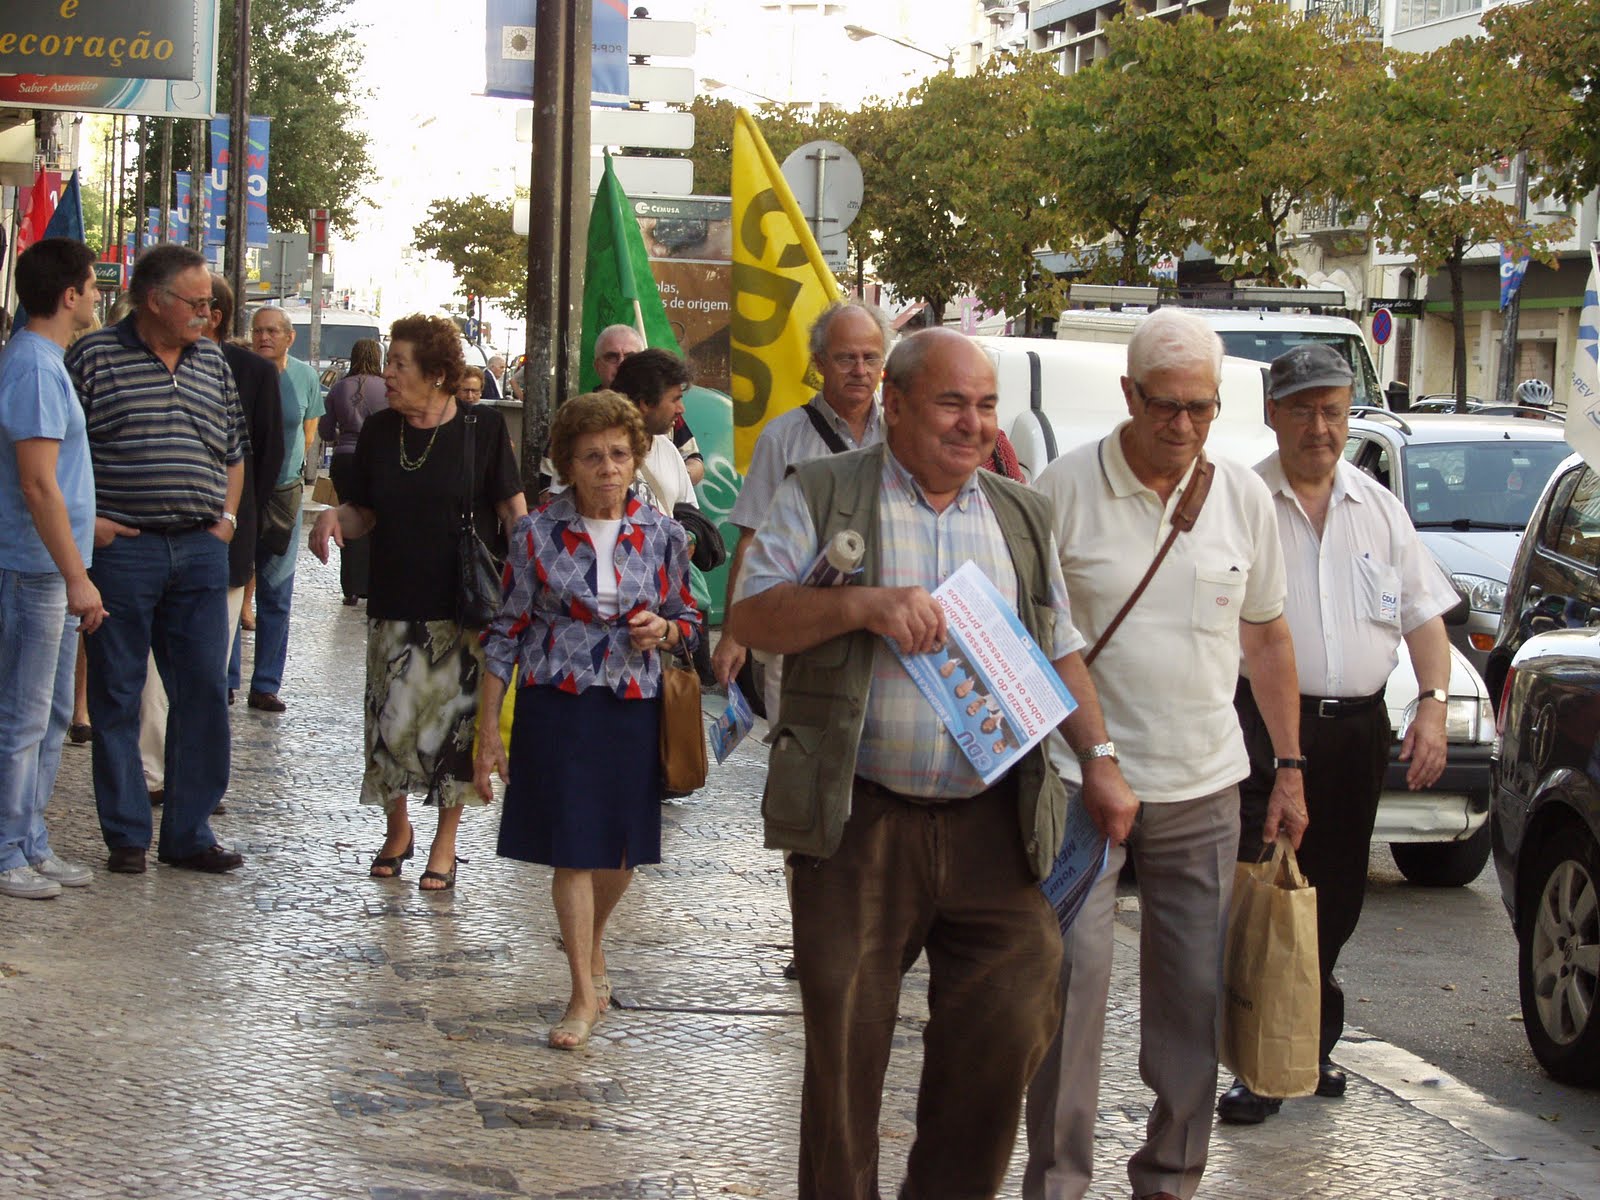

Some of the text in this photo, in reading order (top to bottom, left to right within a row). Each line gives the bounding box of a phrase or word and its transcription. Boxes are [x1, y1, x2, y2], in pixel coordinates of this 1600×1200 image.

[60, 0, 79, 19] e
[0, 31, 174, 68] ecoração
[18, 83, 48, 94] Sabor
[670, 297, 685, 309] de
[687, 299, 731, 313] origem.
[945, 587, 982, 630] privados
[964, 630, 998, 677] interesse
[979, 630, 1016, 681] interesses
[995, 677, 1008, 692] do
[1014, 681, 1026, 695] os
[1005, 691, 1037, 737] Primazia
[1023, 695, 1046, 725] sobre
